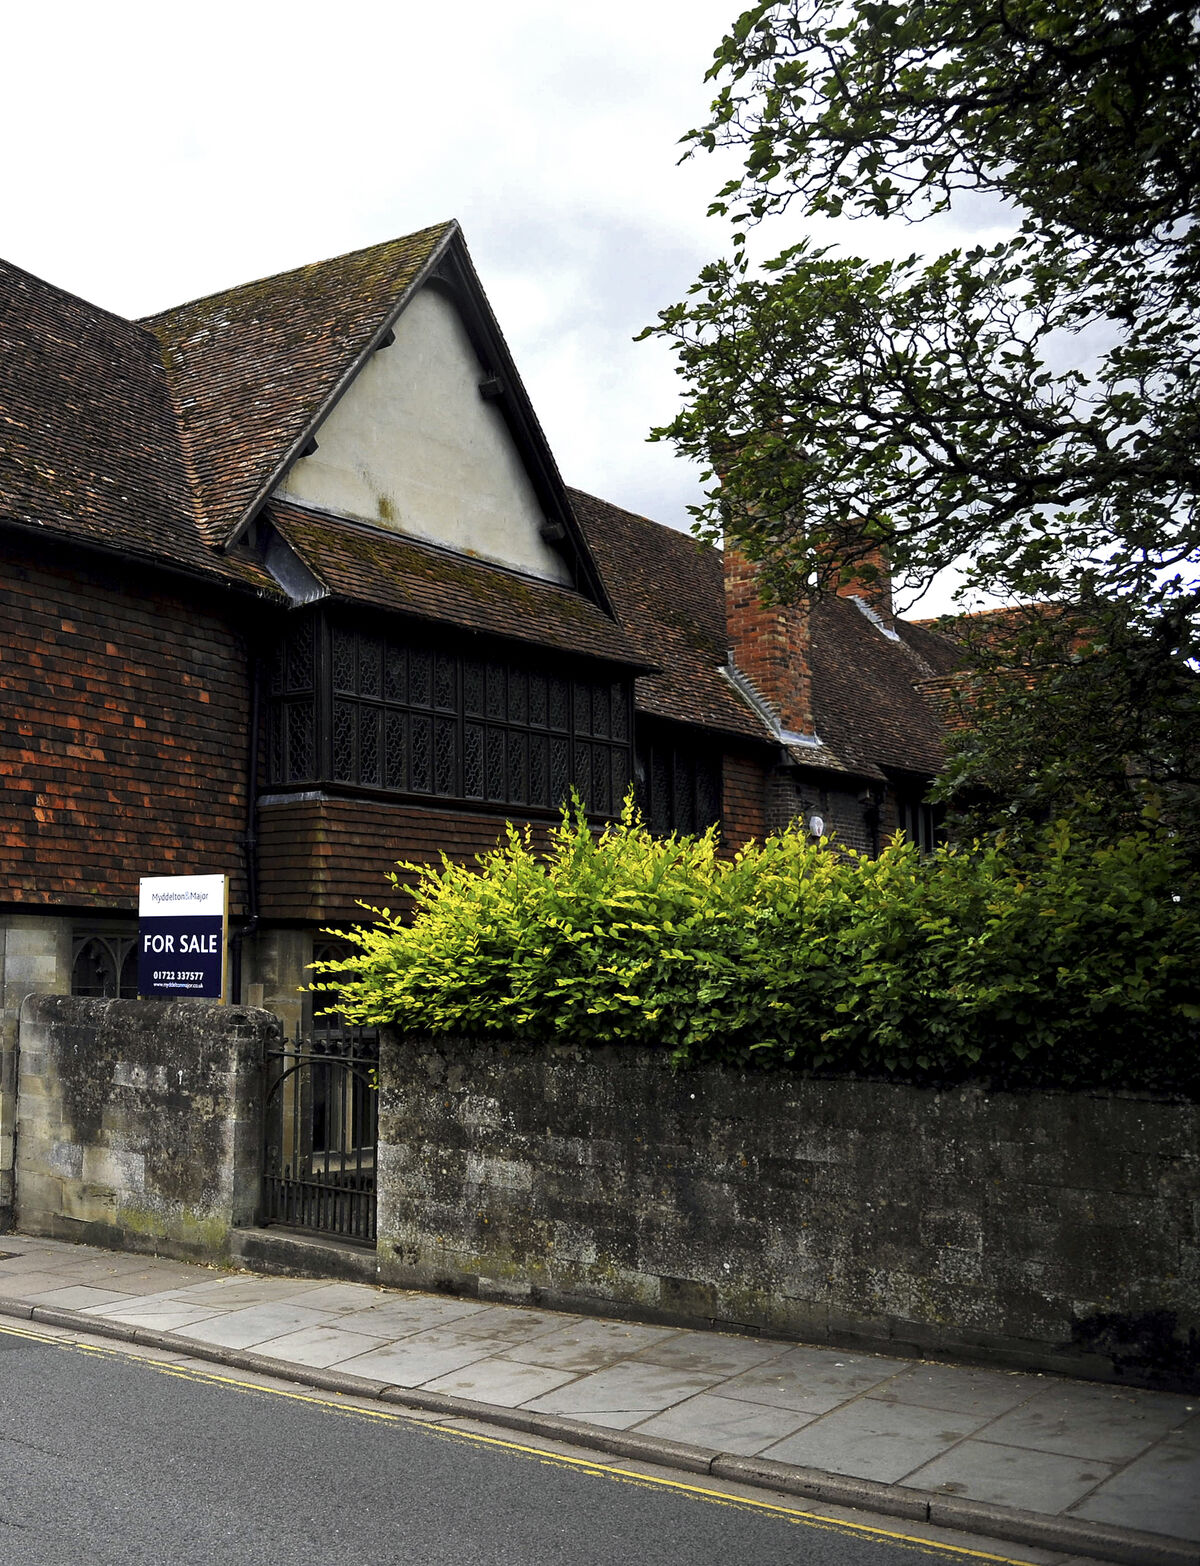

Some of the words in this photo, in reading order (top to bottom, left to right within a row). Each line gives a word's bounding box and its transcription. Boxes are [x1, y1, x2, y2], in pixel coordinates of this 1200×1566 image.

[144, 935, 175, 953] FOR
[179, 935, 217, 953] SALE
[153, 971, 175, 980] 01722
[177, 971, 203, 980] 337577
